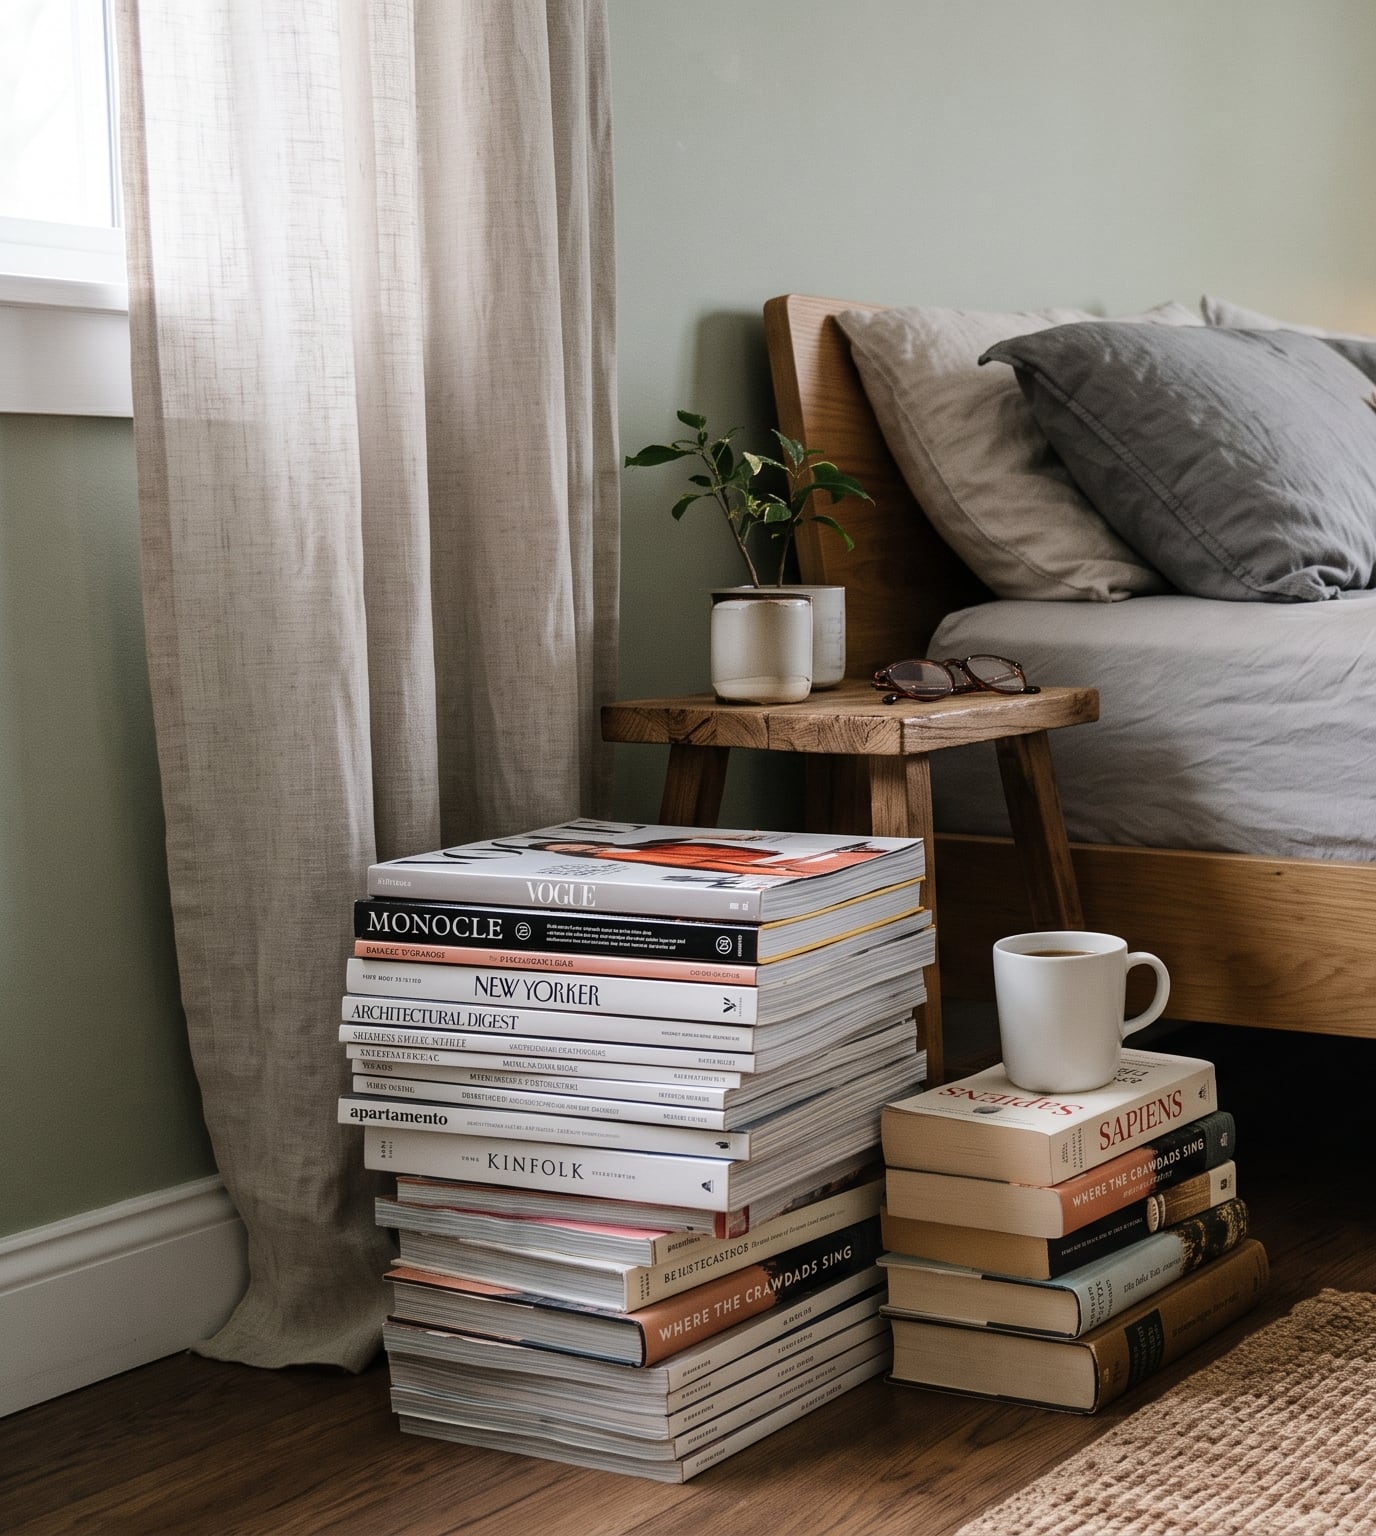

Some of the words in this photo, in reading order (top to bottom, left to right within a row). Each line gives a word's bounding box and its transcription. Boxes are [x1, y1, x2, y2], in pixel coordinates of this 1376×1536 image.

[526, 881, 597, 907] VOGUE
[367, 911, 504, 940] MONOCLE
[474, 976, 520, 998] NEW
[523, 979, 601, 1006] YORKER
[351, 1004, 465, 1026] ARCHITECTURAL
[467, 1013, 520, 1030] DIGEST
[350, 1107, 448, 1126] apartamento
[1099, 1089, 1183, 1150] SAPIENS
[487, 1153, 584, 1180] KINFOLK
[1072, 1183, 1108, 1207] WHERE
[1109, 1173, 1128, 1191] THE
[1130, 1148, 1181, 1181] CRAWDADS
[1183, 1138, 1205, 1158] SING
[658, 1308, 710, 1342] WHERE
[714, 1294, 741, 1318] THE
[745, 1260, 818, 1303] CRAWDADS
[822, 1245, 852, 1269] SING
